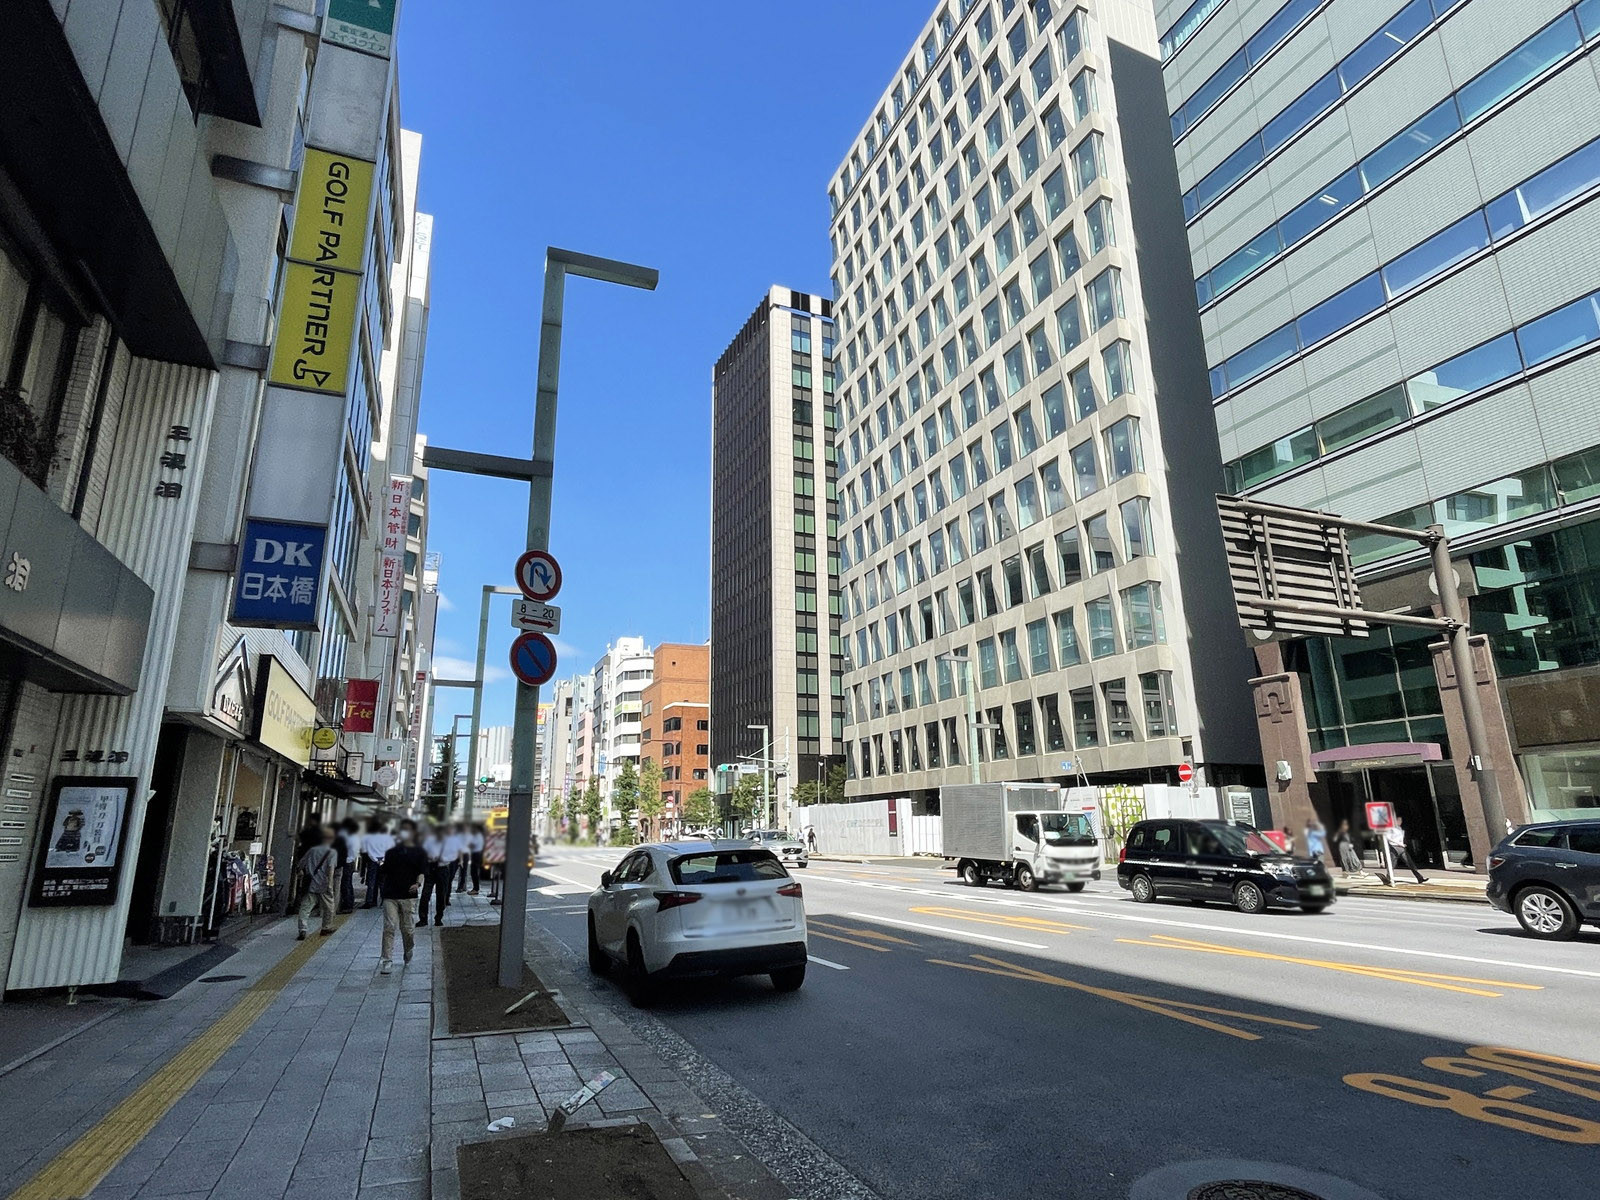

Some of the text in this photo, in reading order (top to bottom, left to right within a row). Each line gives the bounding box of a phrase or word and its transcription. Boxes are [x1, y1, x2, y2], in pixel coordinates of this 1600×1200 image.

[302, 161, 350, 356] GOLF PARTNER
[384, 480, 405, 550] 新日本管財
[252, 538, 315, 567] DK
[241, 572, 315, 605] 日本橋
[377, 556, 397, 632] 新日本リフォーム
[521, 604, 527, 614] 8
[543, 608, 554, 619] 20
